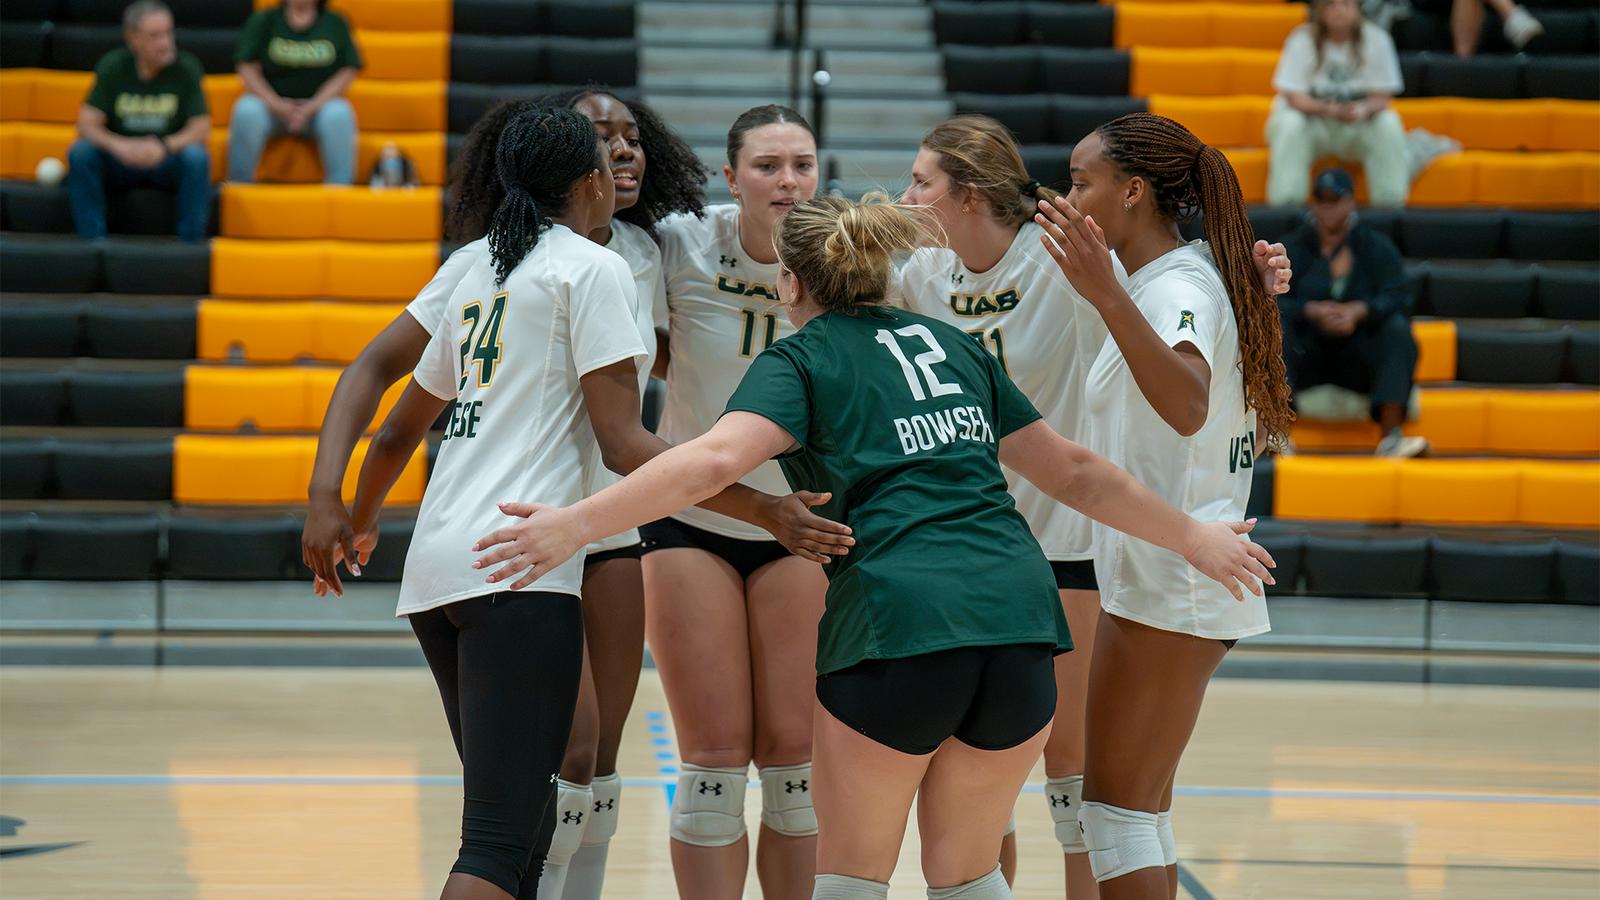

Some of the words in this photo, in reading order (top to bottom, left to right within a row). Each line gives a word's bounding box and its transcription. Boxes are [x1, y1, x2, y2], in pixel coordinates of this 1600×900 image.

[715, 272, 780, 303] UA
[949, 287, 1021, 318] UAB
[459, 291, 509, 392] 24
[739, 307, 778, 358] 11
[965, 327, 1012, 378] 1
[875, 324, 963, 401] 12
[442, 400, 483, 440] ESE
